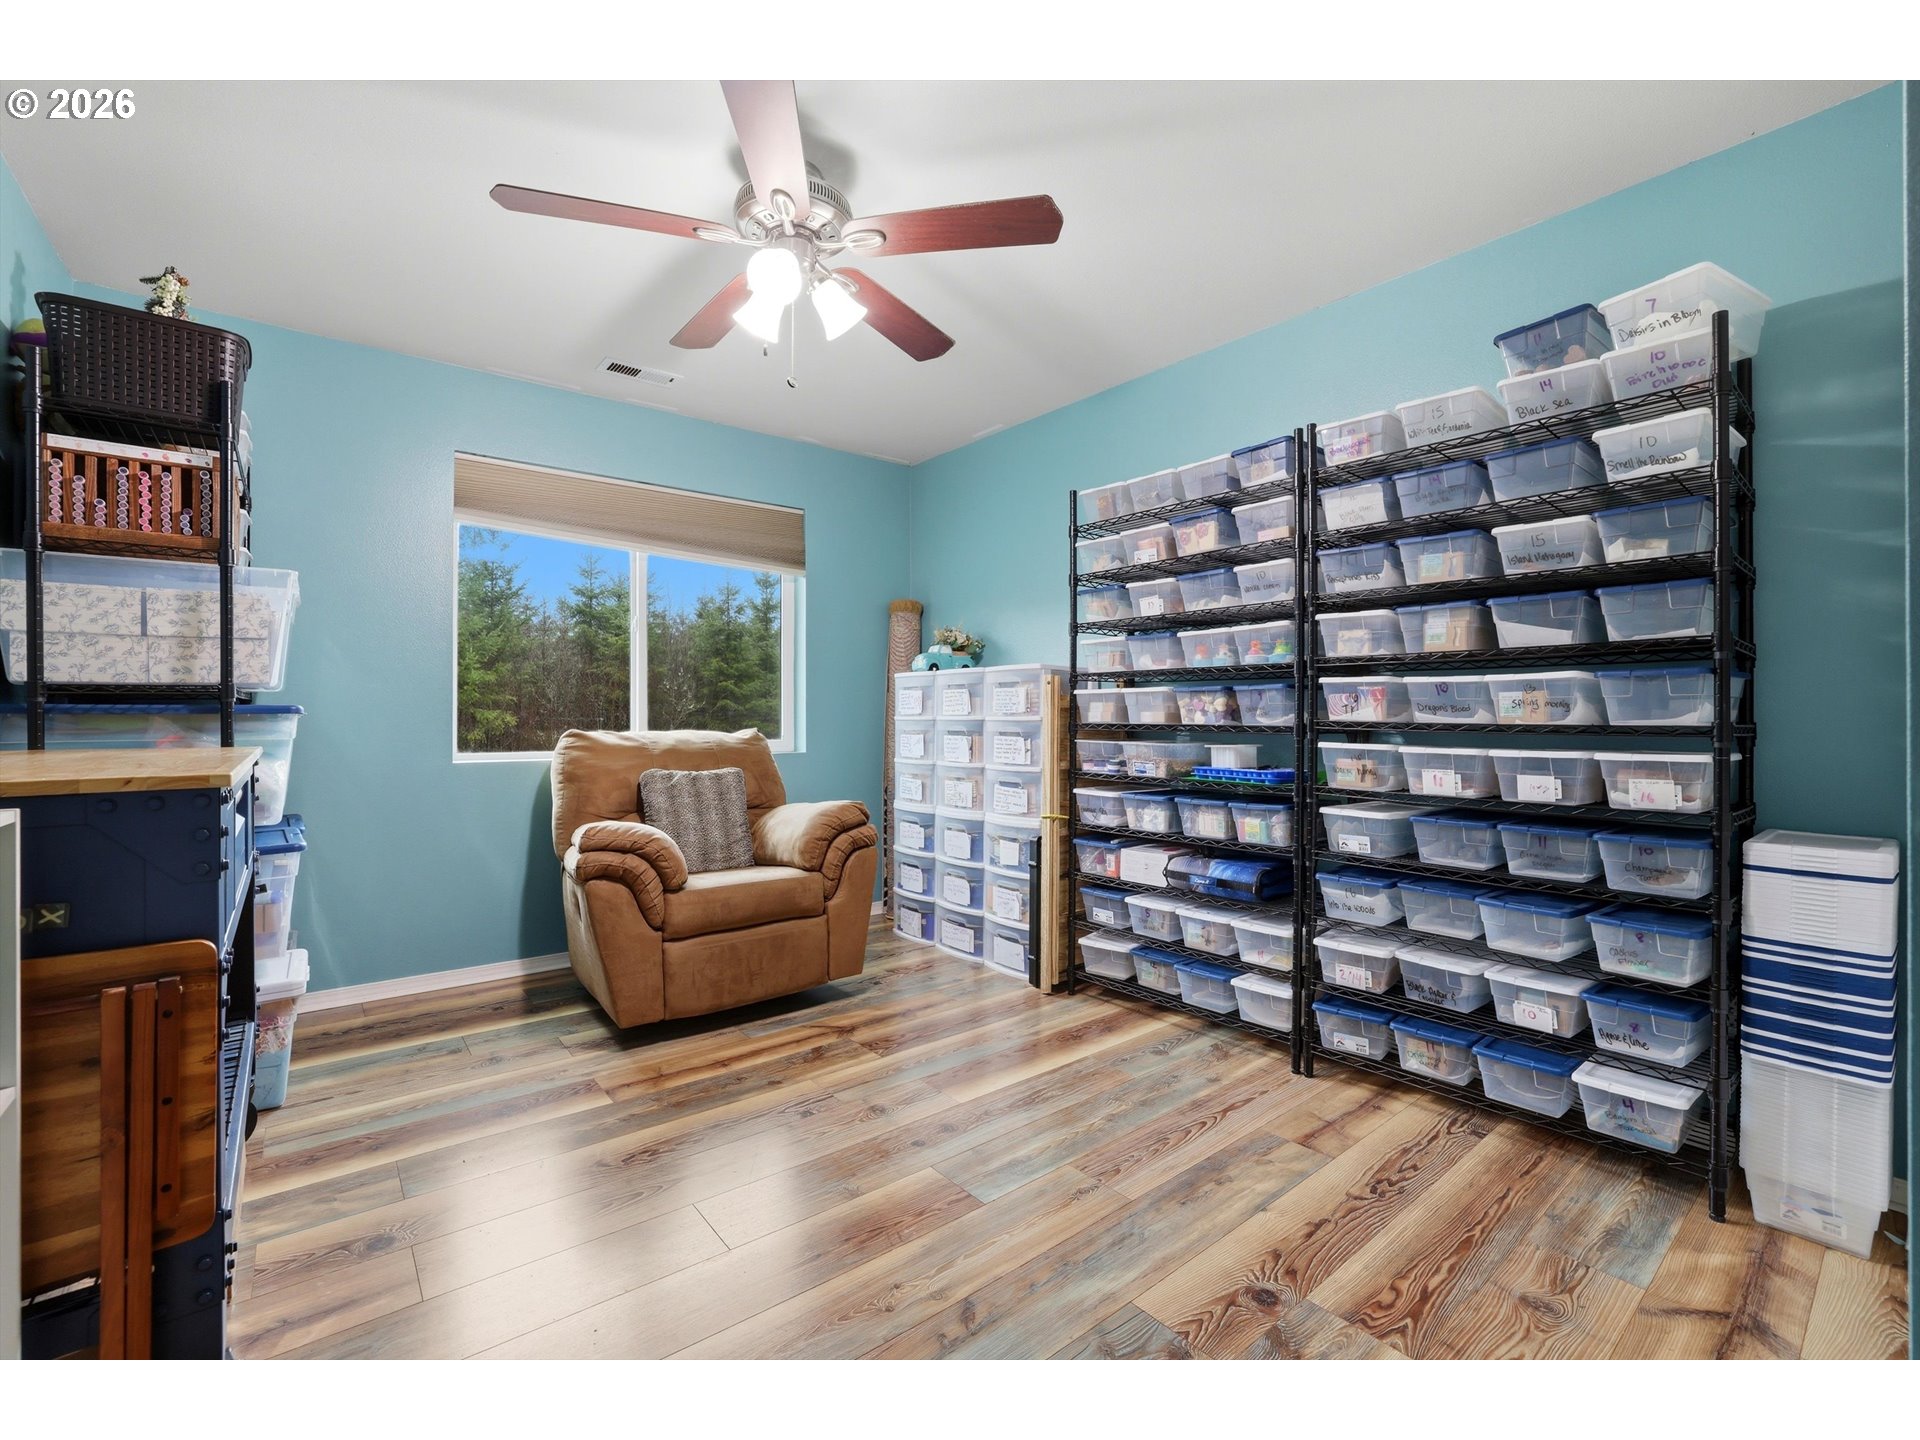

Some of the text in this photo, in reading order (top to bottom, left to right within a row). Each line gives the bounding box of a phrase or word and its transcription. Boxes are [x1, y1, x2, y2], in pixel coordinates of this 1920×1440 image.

[1645, 298, 1656, 313] 7
[1656, 319, 1671, 329] in
[1649, 351, 1665, 363] 10
[1540, 378, 1553, 392] 14
[1515, 404, 1549, 419] Black
[1640, 436, 1657, 448] 10
[1606, 458, 1635, 472] Smell
[1531, 533, 1546, 548] 15
[1506, 551, 1575, 566] Island Mahogany
[1435, 682, 1449, 696] 10
[1449, 703, 1471, 713] Blood
[1622, 1098, 1635, 1113] 4
